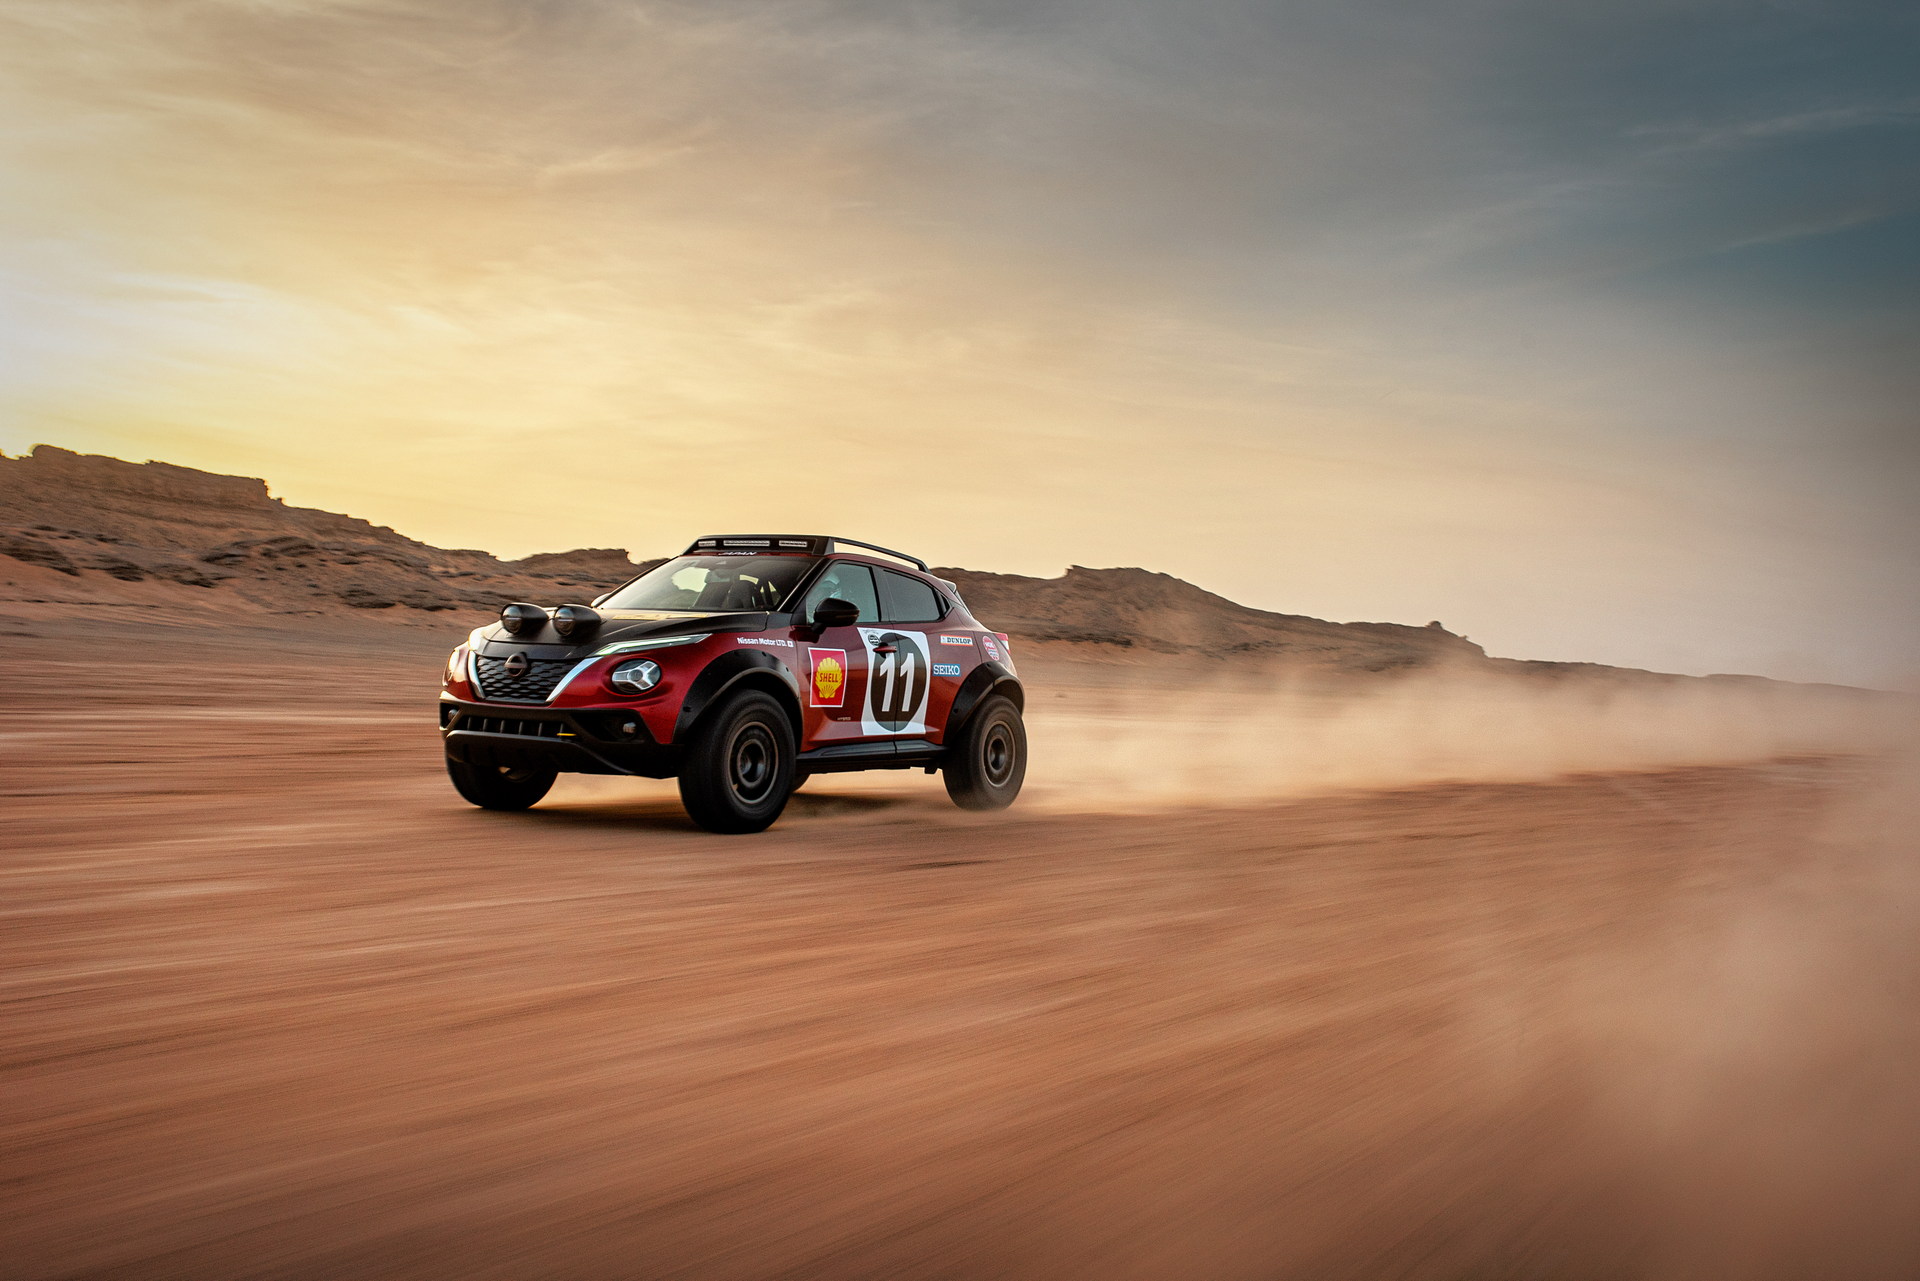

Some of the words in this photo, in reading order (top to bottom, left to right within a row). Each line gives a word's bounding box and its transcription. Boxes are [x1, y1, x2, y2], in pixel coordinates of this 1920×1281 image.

[737, 637, 759, 645] Nissan
[759, 638, 776, 646] Motor
[947, 637, 971, 645] DUNLOP
[933, 664, 960, 676] SEIKO
[819, 672, 839, 683] SHELL
[880, 653, 915, 712] 11
